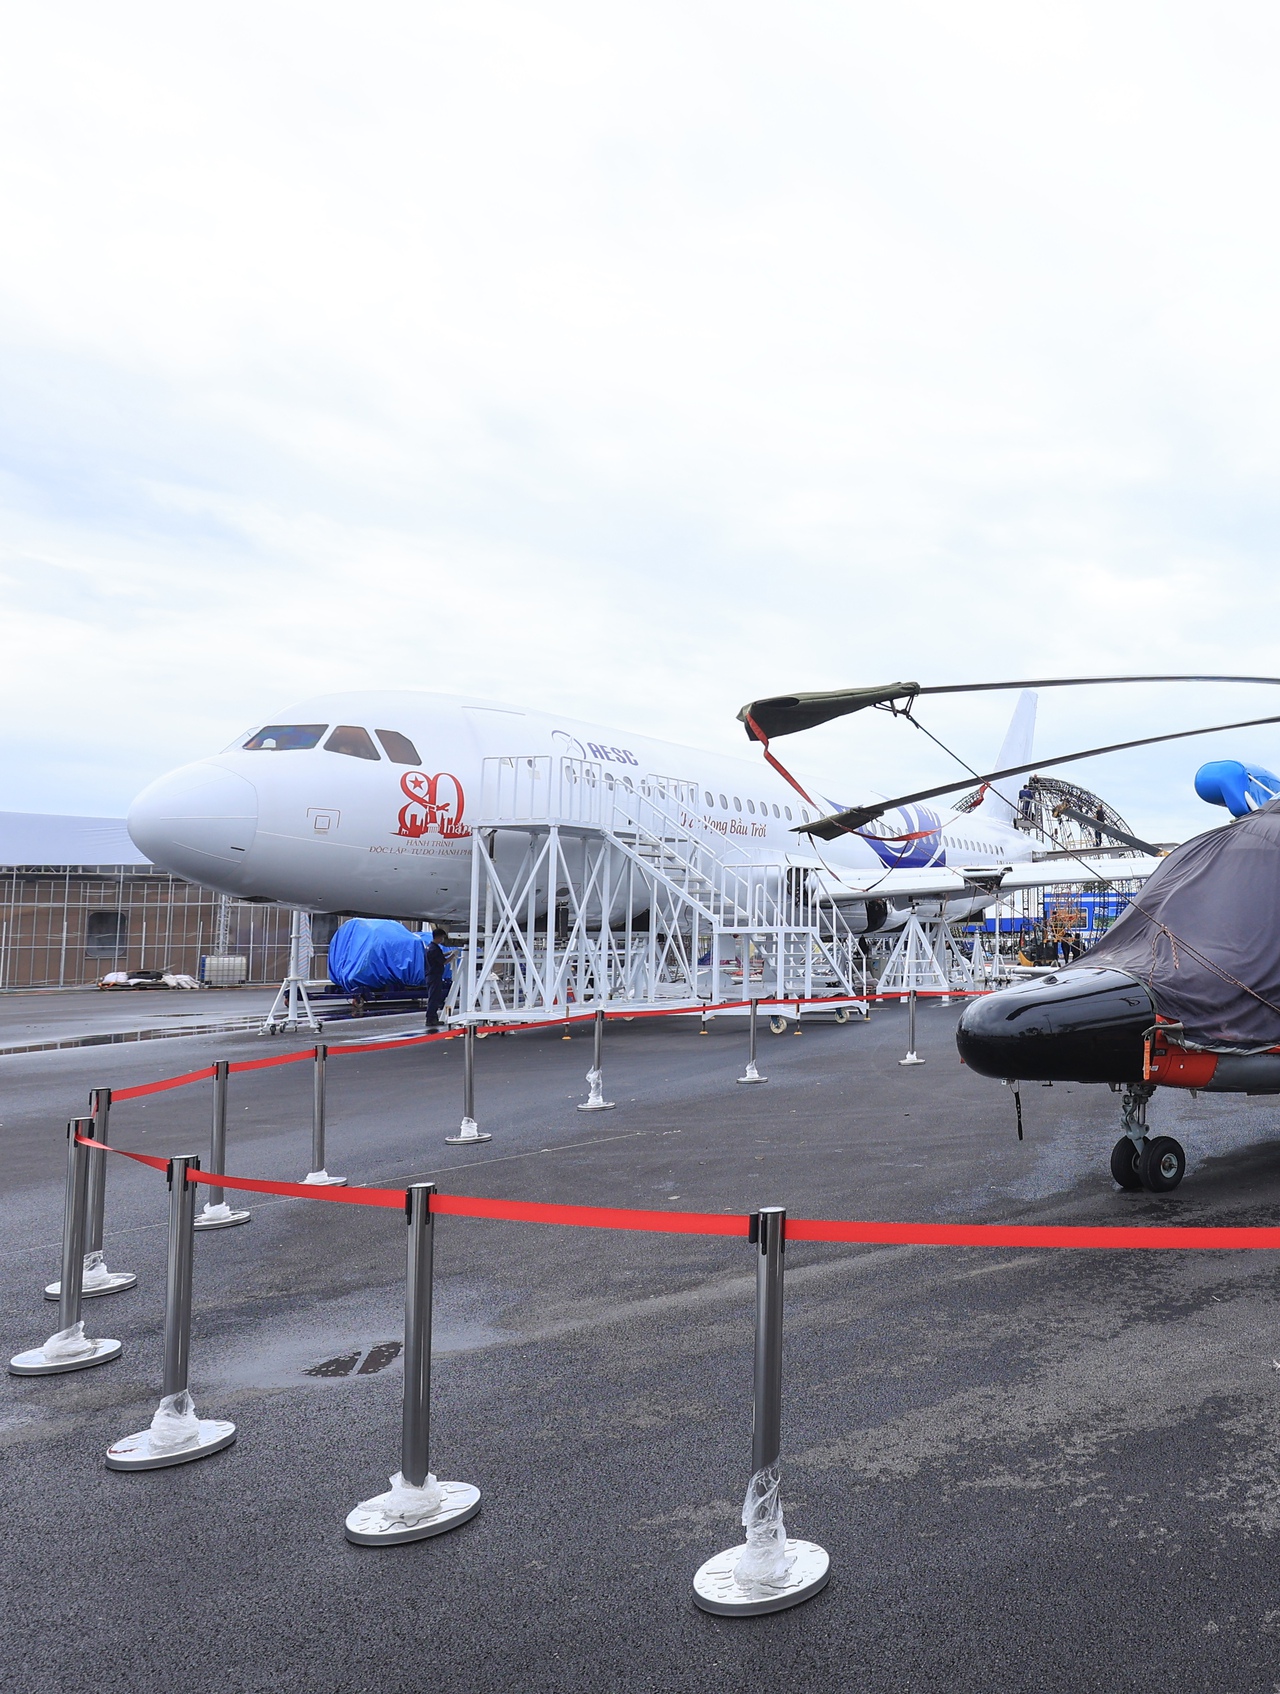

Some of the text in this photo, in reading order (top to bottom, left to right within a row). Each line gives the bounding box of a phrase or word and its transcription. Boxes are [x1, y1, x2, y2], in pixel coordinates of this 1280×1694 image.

[587, 742, 639, 766] AESC
[398, 771, 465, 837] 80
[703, 815, 728, 836] Vọng
[729, 817, 748, 836] Bầu
[750, 822, 767, 838] Trời
[369, 845, 389, 854] ĐỘC
[389, 846, 407, 855] LẬP
[422, 848, 435, 856] DO
[406, 839, 454, 848] HÀNH TRÌNH
